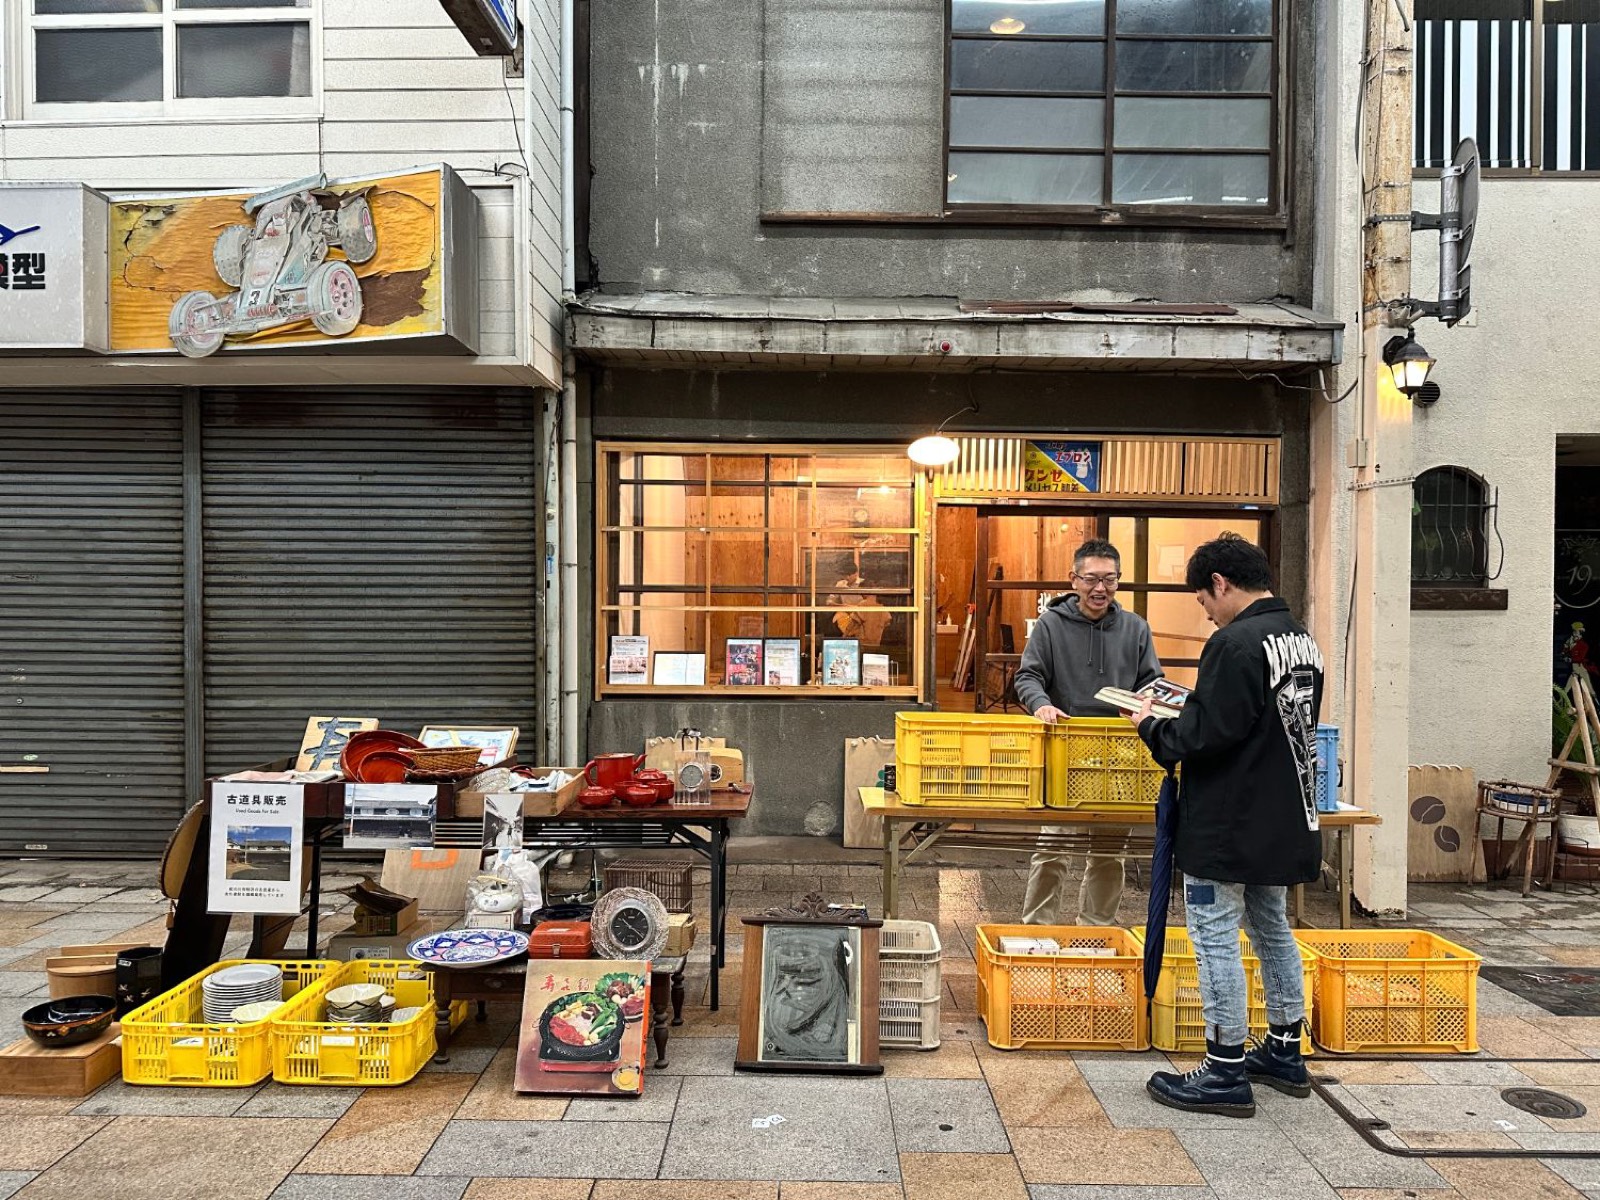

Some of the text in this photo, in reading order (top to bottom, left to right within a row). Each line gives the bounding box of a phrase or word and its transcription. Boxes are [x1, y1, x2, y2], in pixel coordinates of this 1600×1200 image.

[226, 795, 287, 806] 古道具販売
